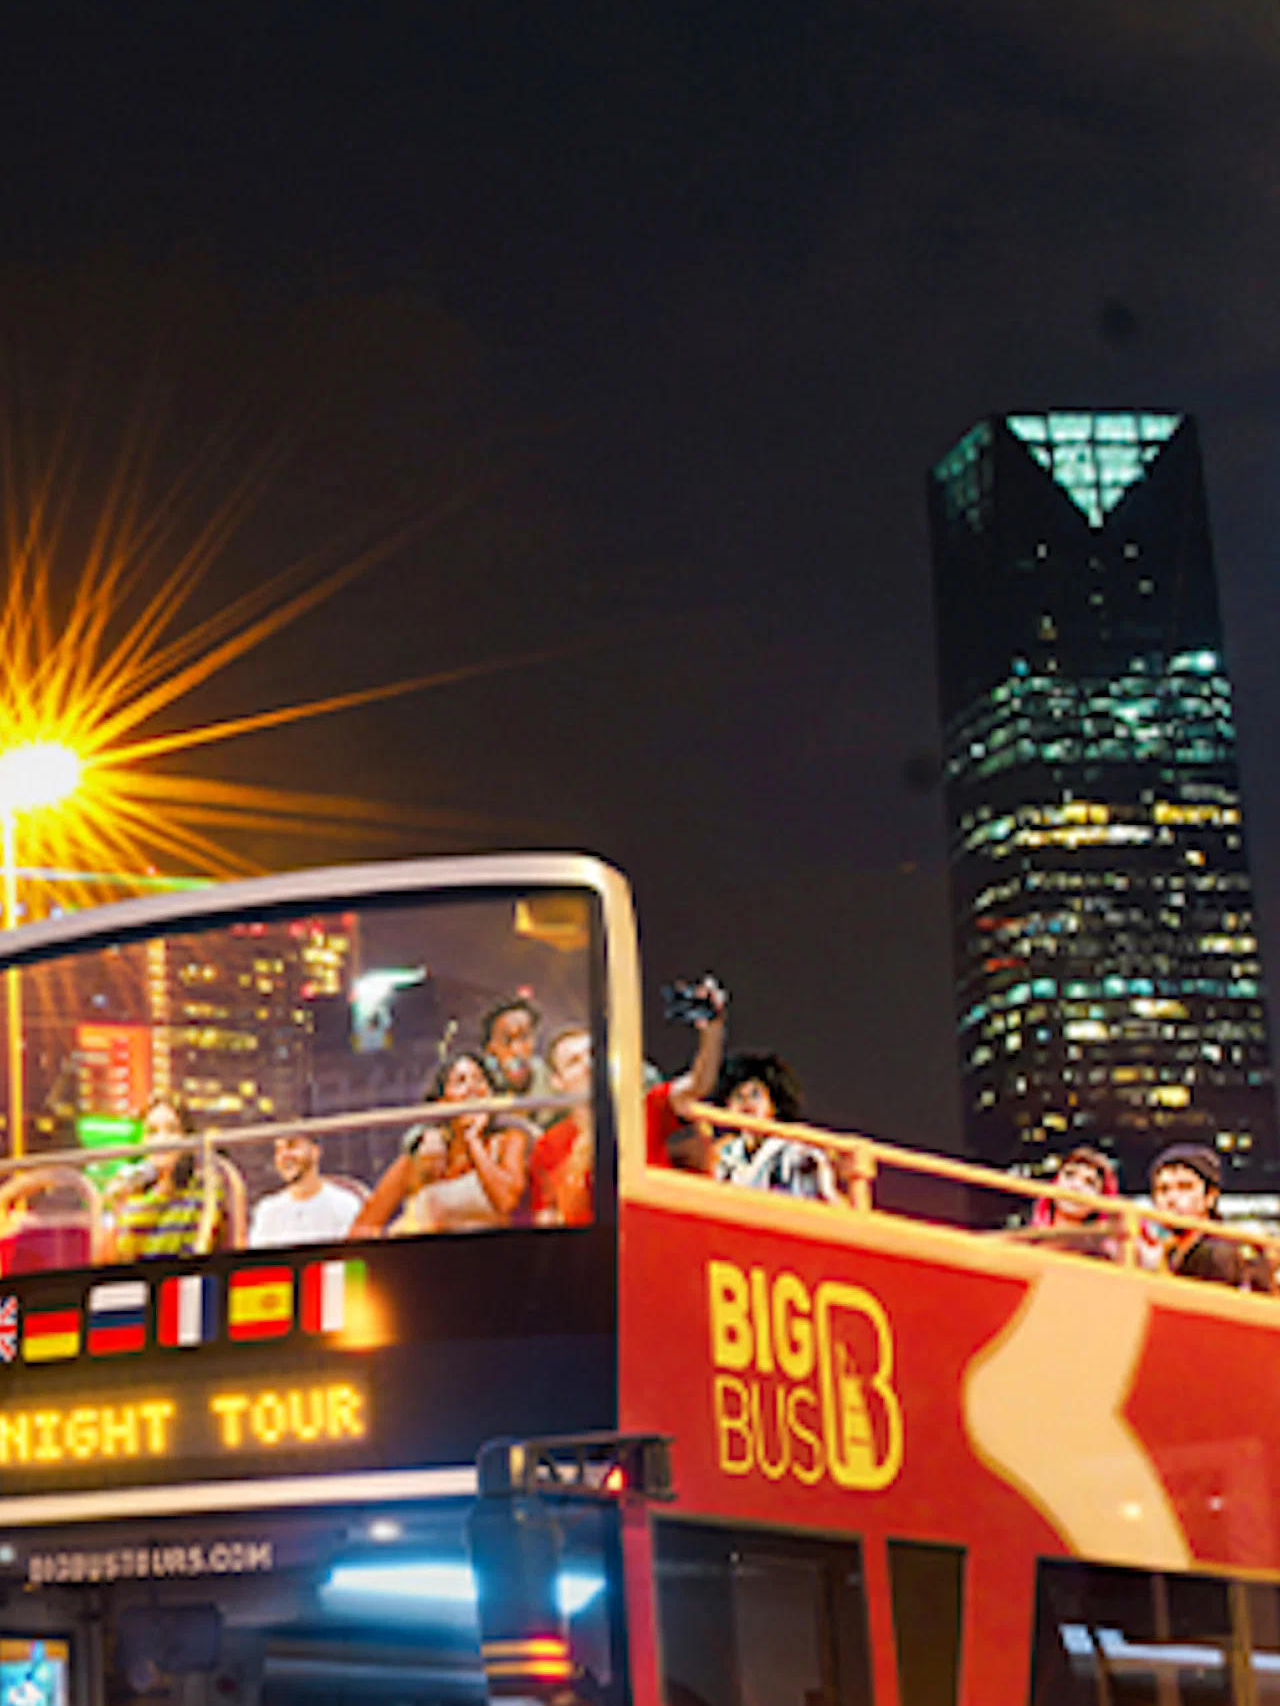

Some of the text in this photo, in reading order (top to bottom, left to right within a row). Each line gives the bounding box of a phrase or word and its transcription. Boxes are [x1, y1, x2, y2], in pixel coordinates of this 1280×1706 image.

[709, 1259, 814, 1380] BIG
[209, 1383, 366, 1449] TOUR
[715, 1373, 825, 1485] BUS
